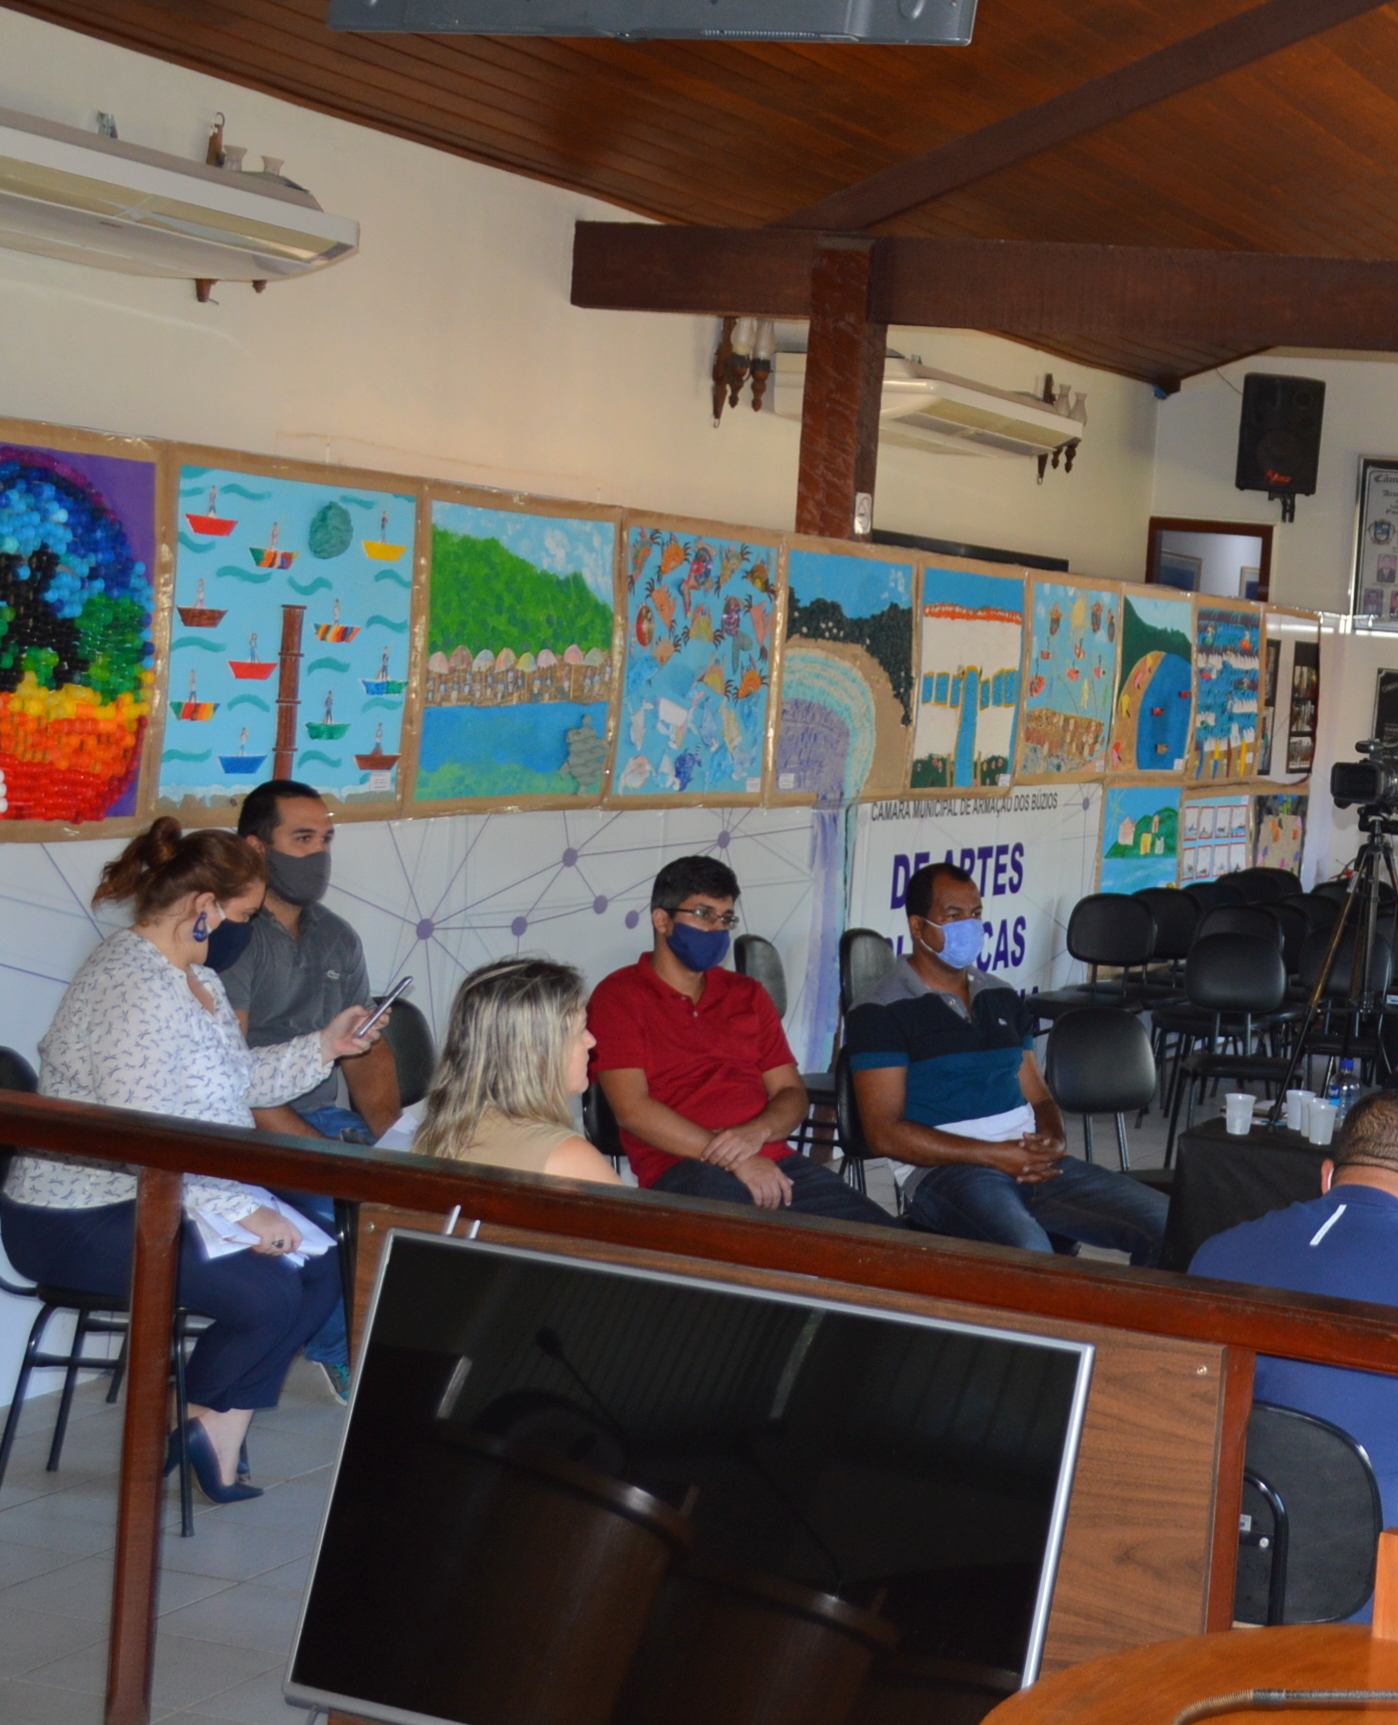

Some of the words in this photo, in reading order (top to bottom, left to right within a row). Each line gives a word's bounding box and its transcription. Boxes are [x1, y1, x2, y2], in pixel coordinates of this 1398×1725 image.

[912, 799, 957, 819] MUNICIPAL
[960, 798, 971, 815] DE
[1014, 794, 1030, 812] DOS
[1030, 788, 1058, 811] BÚZIOS
[944, 842, 1024, 898] RTES
